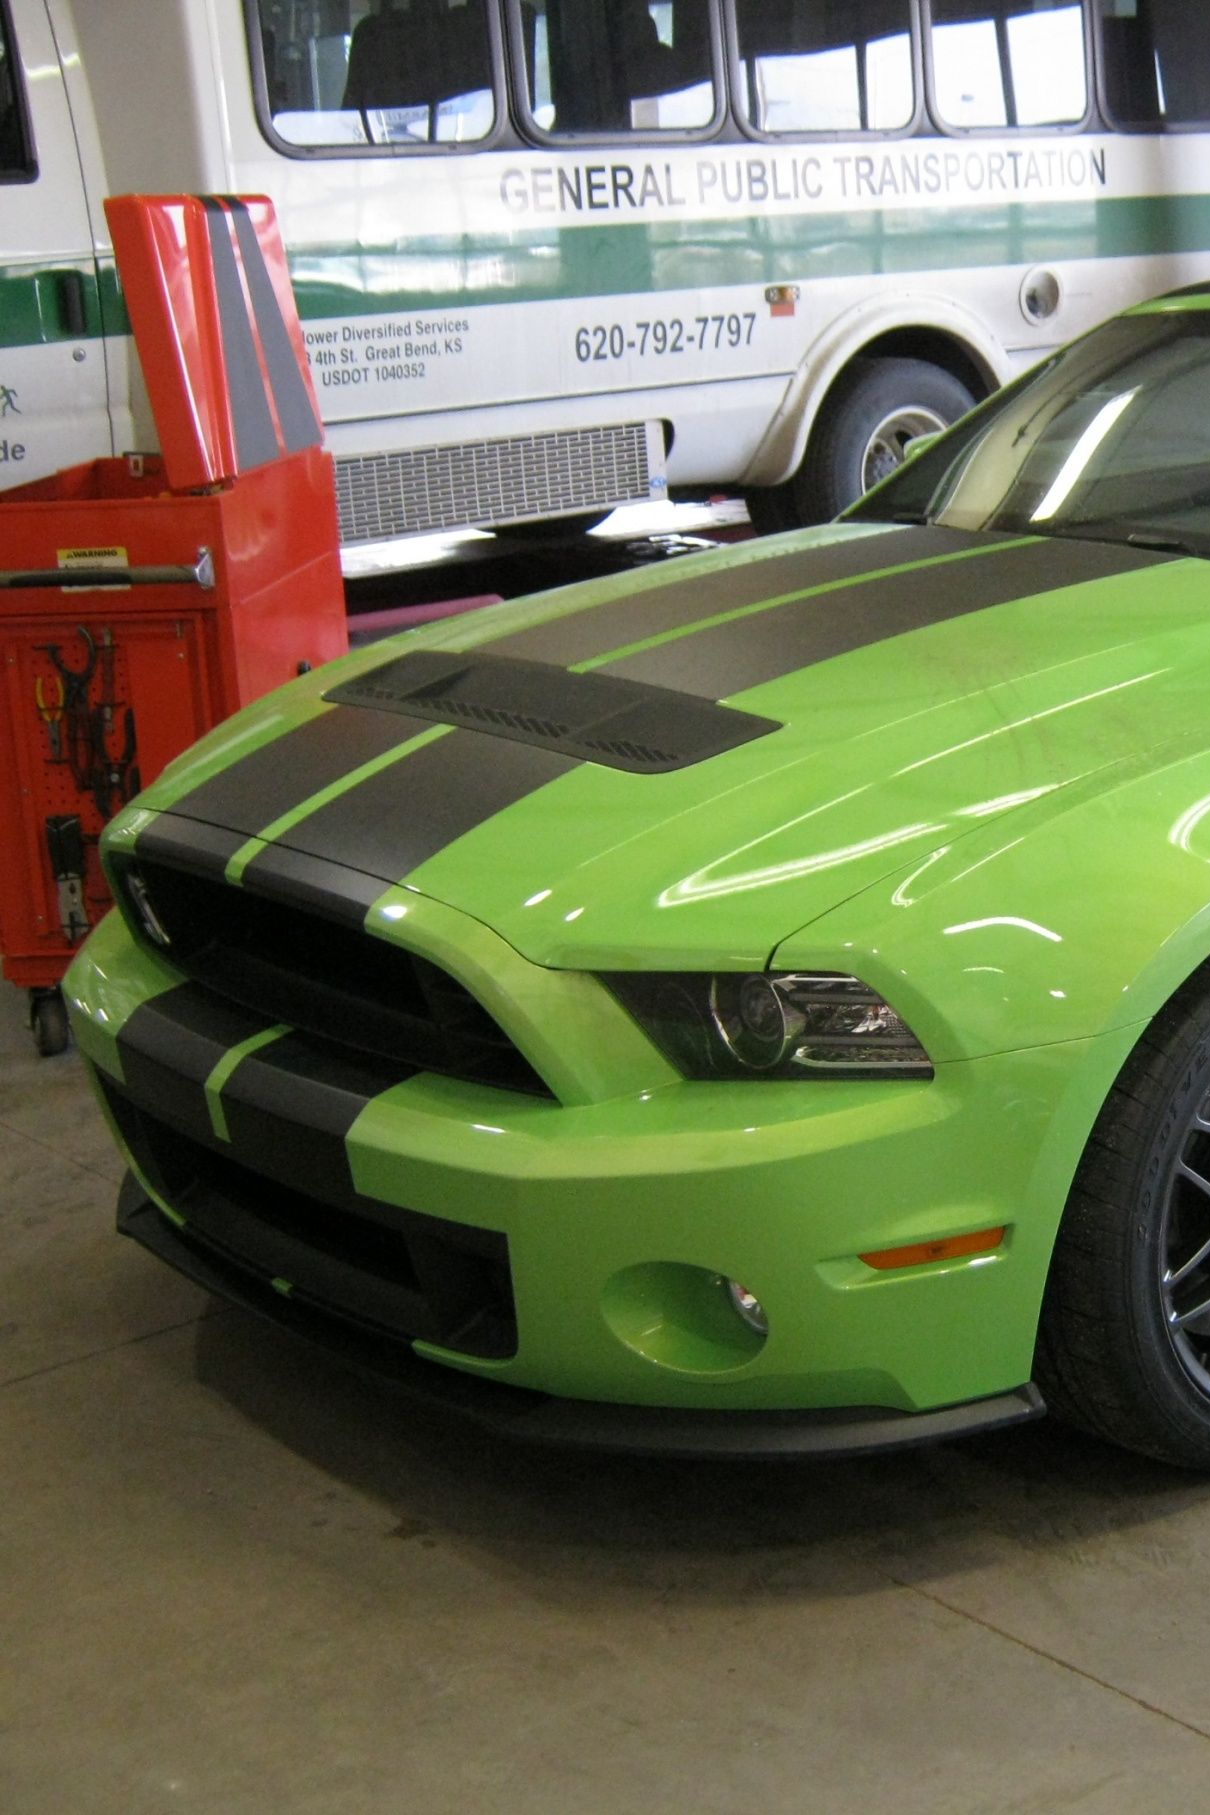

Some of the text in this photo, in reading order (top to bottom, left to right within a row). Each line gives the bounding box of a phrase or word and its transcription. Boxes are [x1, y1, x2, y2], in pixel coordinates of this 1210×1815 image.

[500, 147, 1106, 213] GENERAL PUBLIC TRANSPORTATION
[342, 322, 411, 341] Diversified
[416, 319, 469, 336] Services
[575, 312, 757, 363] 620-792-7797
[315, 349, 336, 366] 4th
[341, 347, 357, 364] St.
[365, 344, 401, 361] Great
[404, 341, 441, 358] Bend,
[445, 338, 462, 353] KS
[322, 363, 425, 386] USDOT 1040352
